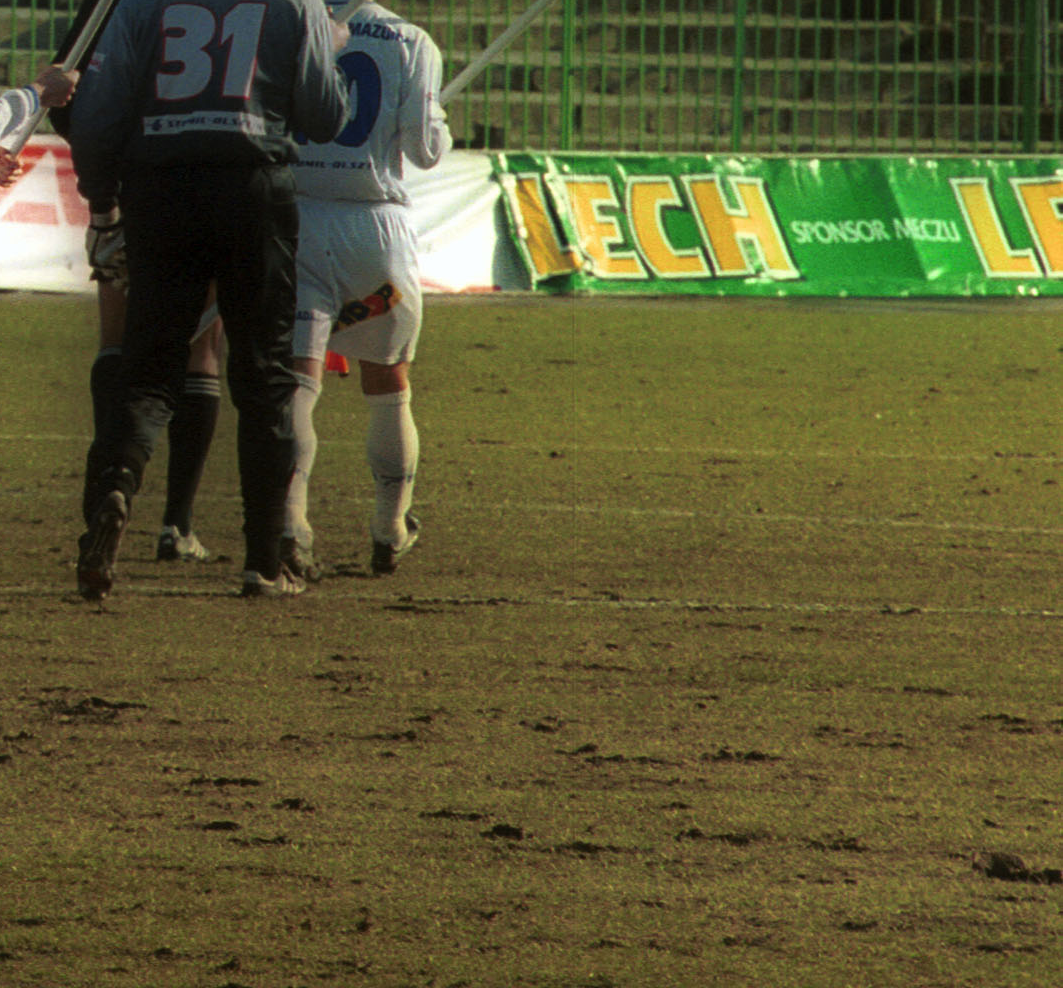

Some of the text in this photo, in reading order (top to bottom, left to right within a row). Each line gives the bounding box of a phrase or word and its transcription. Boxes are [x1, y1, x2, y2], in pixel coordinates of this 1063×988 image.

[155, 0, 270, 101] 31
[501, 172, 802, 282] LECH
[790, 219, 891, 244] SPONSOR
